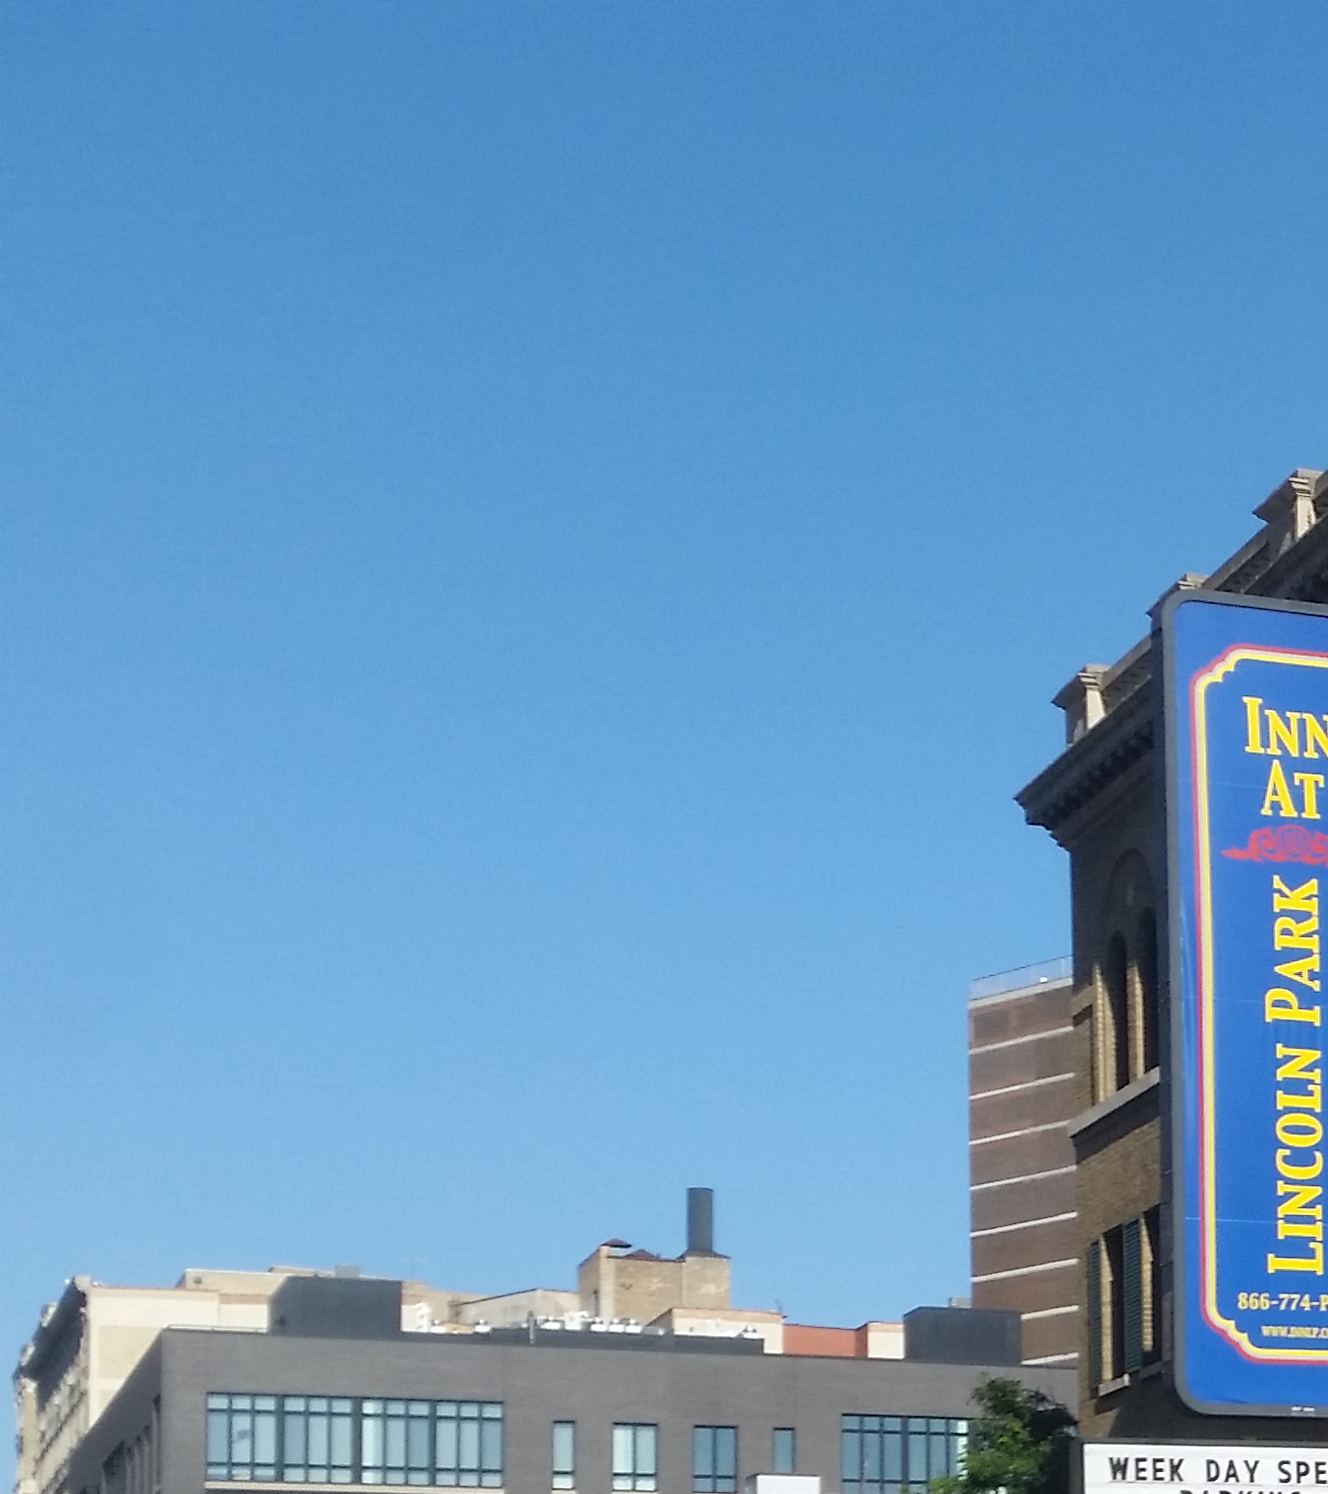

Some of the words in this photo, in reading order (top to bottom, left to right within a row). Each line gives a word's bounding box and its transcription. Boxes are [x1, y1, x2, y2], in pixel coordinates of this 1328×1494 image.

[1260, 759, 1325, 820] AT
[1265, 874, 1322, 1027] PARK
[1267, 1044, 1324, 1276] LINCOLN
[1108, 1457, 1184, 1482] WEEK
[1206, 1459, 1259, 1483] DAY
